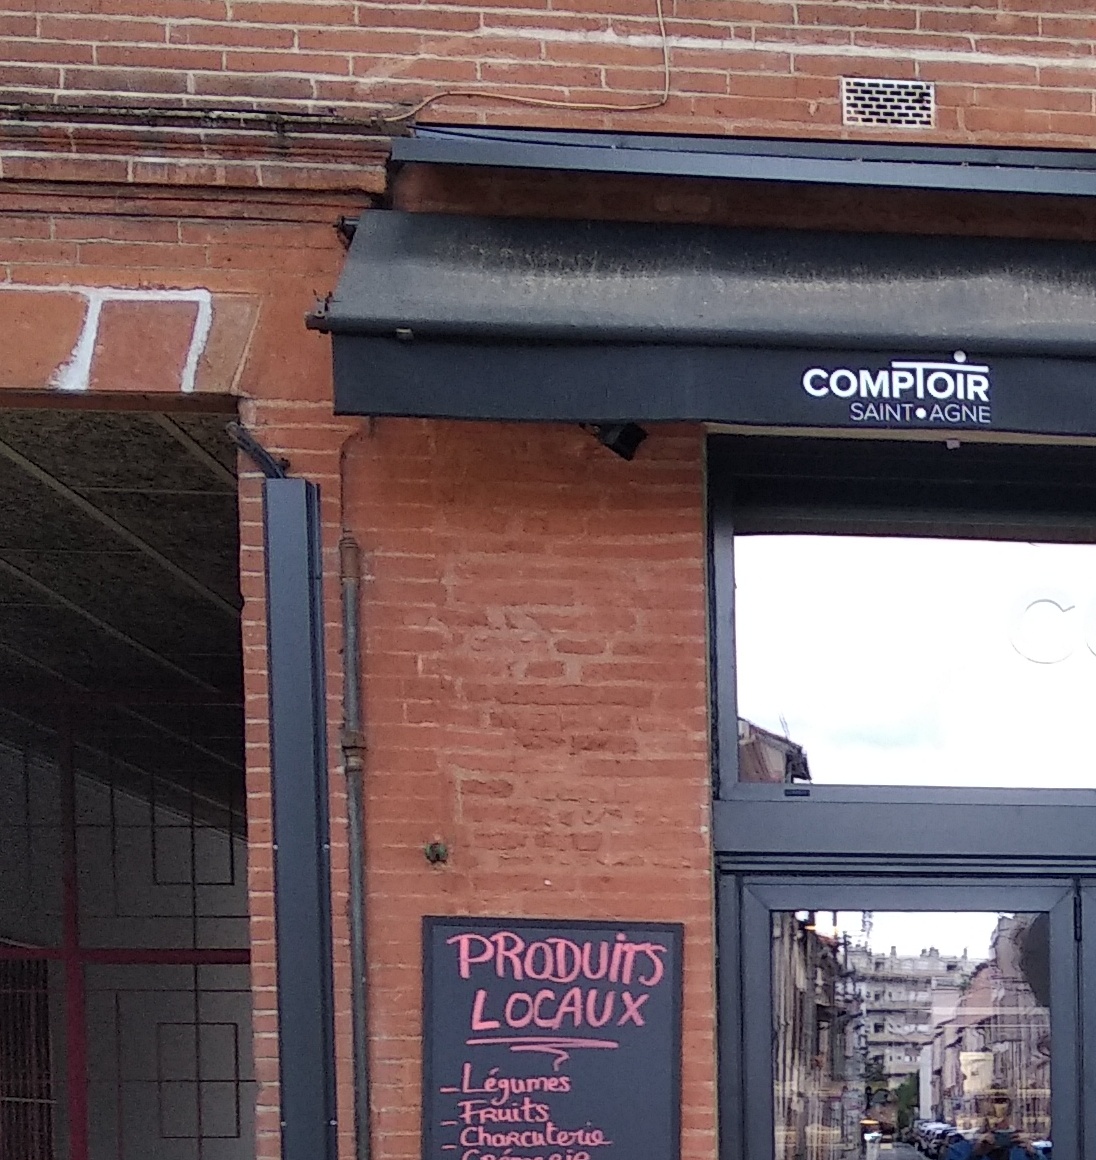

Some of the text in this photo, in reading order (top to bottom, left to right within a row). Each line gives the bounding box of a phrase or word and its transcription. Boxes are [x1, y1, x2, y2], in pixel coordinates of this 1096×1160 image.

[802, 350, 990, 402] COMPTOIR
[446, 931, 668, 987] PRODUITS
[470, 986, 650, 1031] LOCAUX
[461, 1062, 571, 1106] Légumes
[457, 1096, 550, 1124] Fruits
[459, 1118, 613, 1148] Charcuterie
